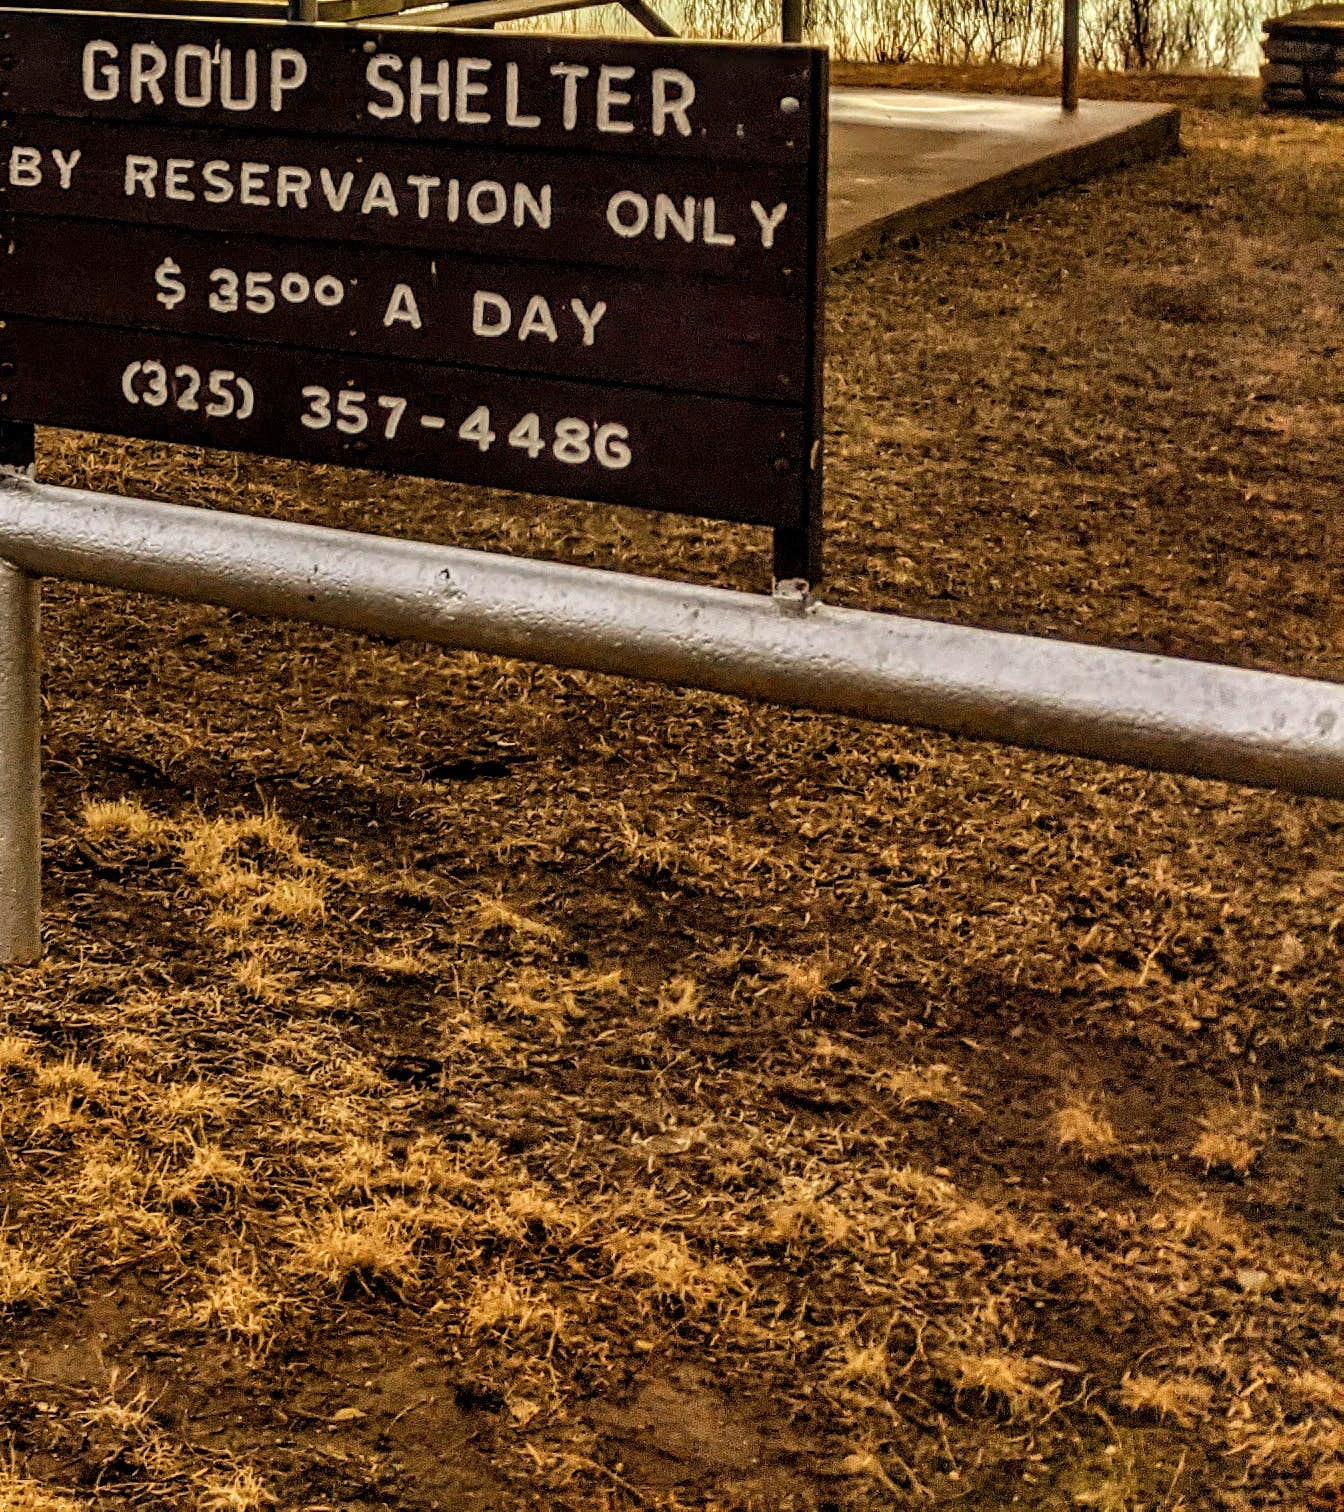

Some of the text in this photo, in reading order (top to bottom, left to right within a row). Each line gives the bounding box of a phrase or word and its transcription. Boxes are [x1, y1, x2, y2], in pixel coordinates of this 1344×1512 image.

[83, 40, 695, 136] GROUP SHELTER
[10, 147, 787, 248] BY RESERVATION ONLY
[383, 285, 421, 329] A
[473, 291, 606, 345] DAY
[122, 360, 631, 469] (325) 357-4486
